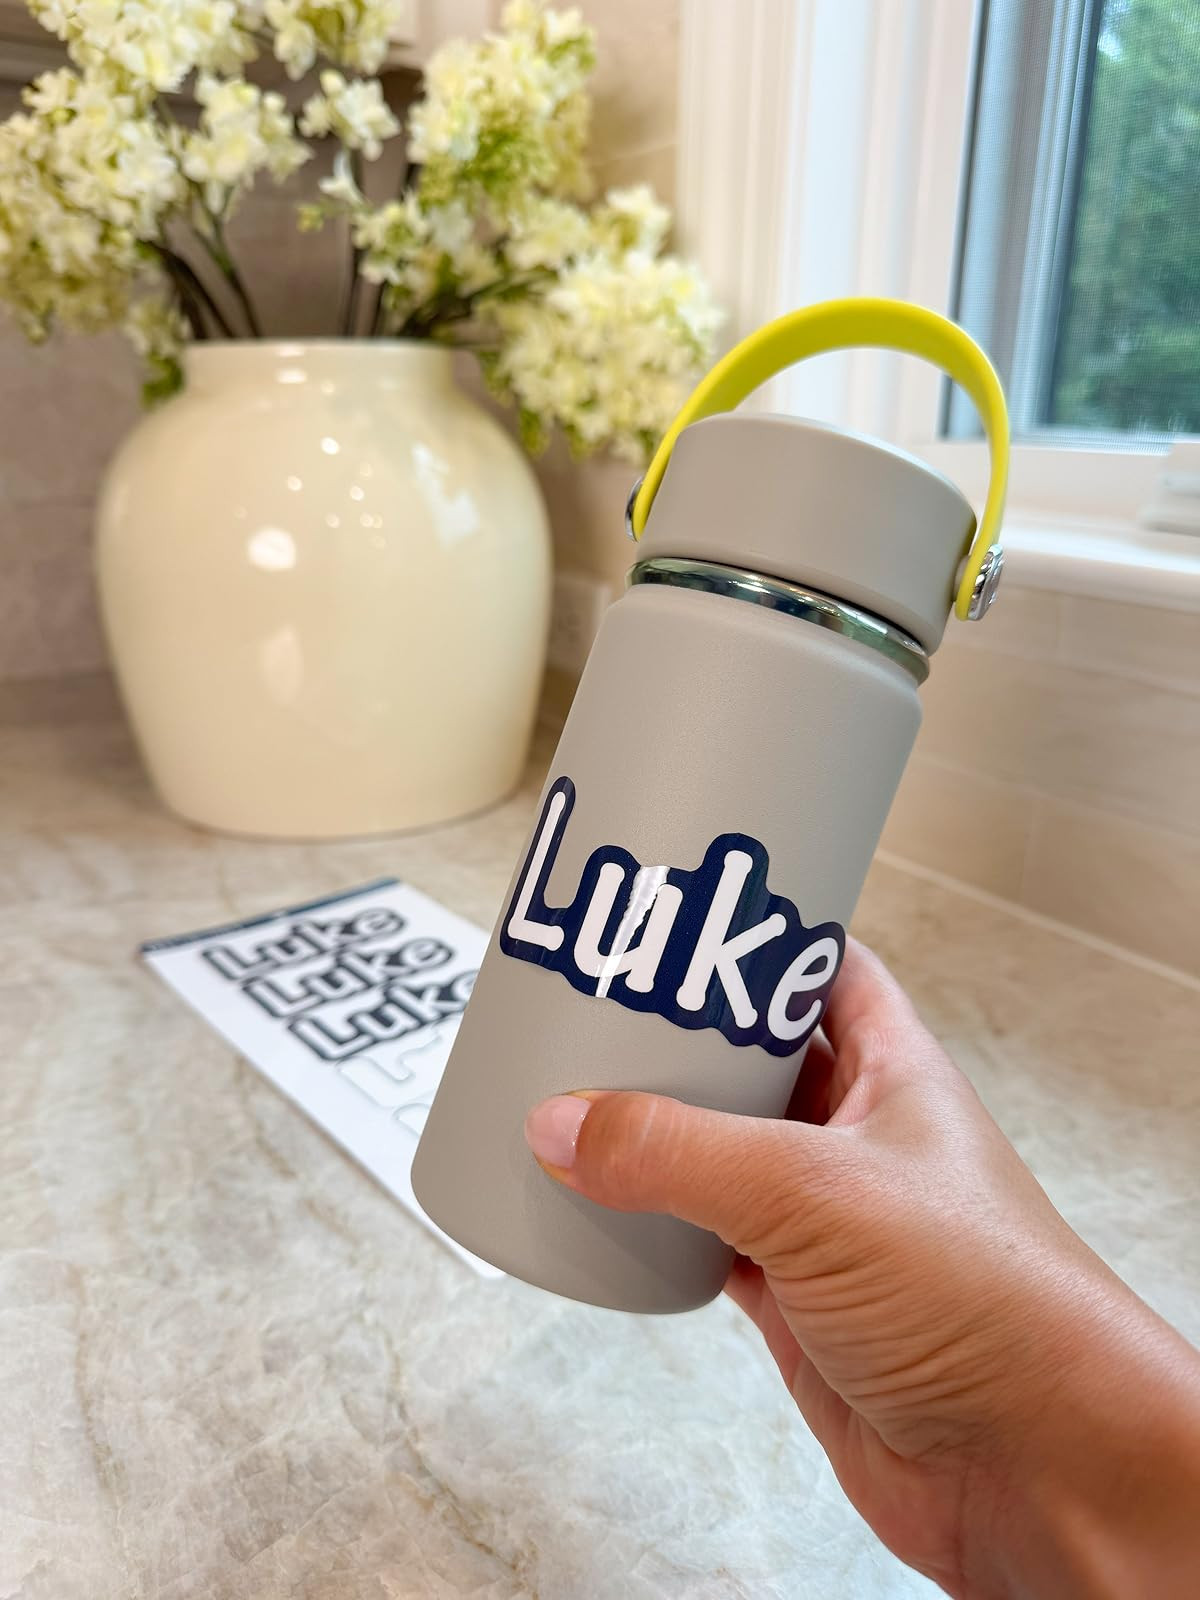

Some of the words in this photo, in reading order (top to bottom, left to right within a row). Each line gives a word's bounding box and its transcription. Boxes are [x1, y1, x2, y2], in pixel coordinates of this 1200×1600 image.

[205, 908, 404, 979] Luke
[507, 791, 839, 1041] Luke
[243, 940, 454, 1016] Luke
